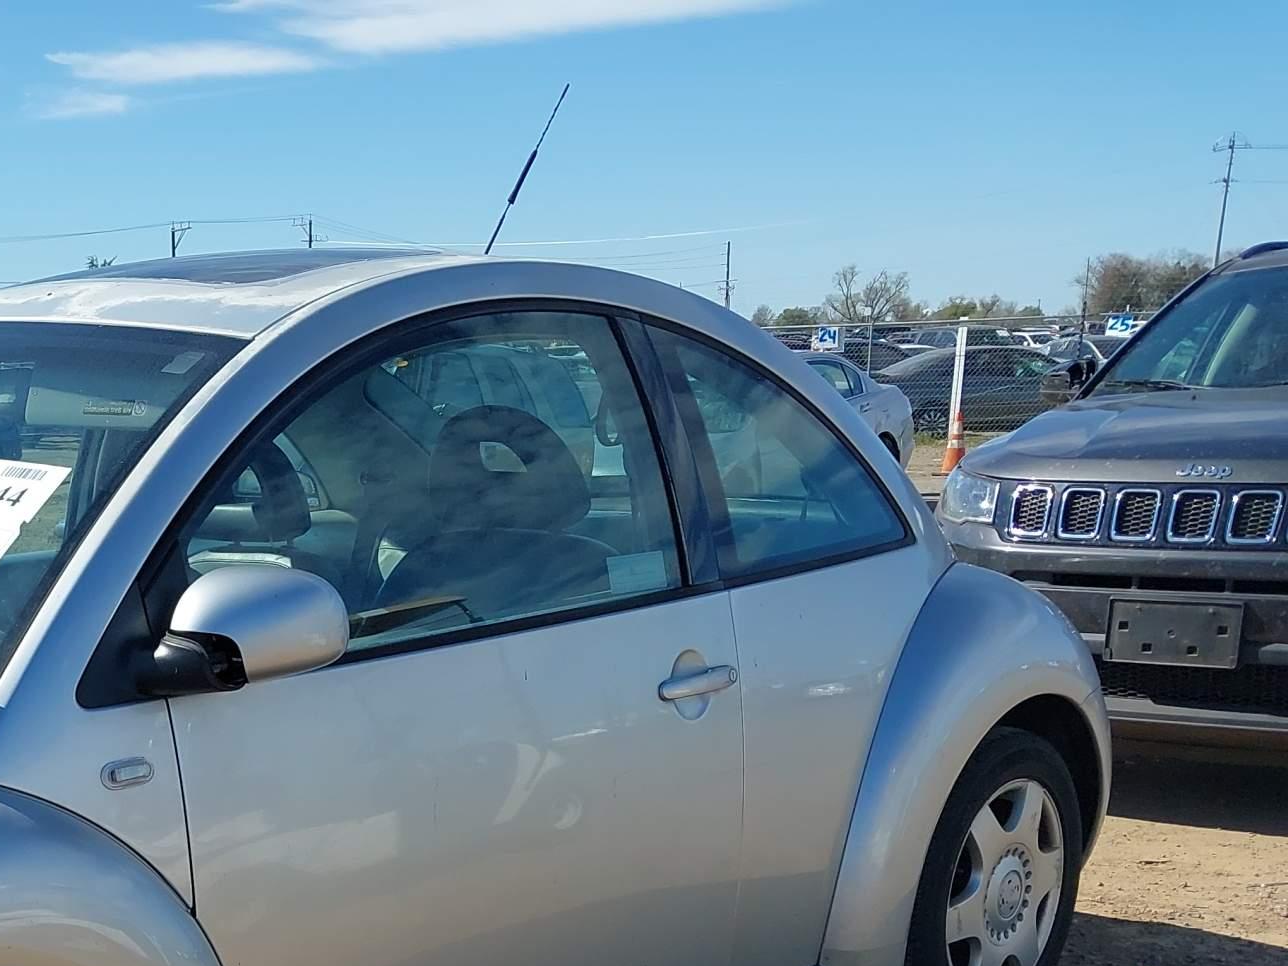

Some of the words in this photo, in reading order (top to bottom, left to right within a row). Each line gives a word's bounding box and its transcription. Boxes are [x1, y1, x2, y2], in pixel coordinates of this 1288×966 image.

[1108, 315, 1132, 333] 25
[819, 327, 837, 344] 24
[1175, 463, 1233, 479] Jeep
